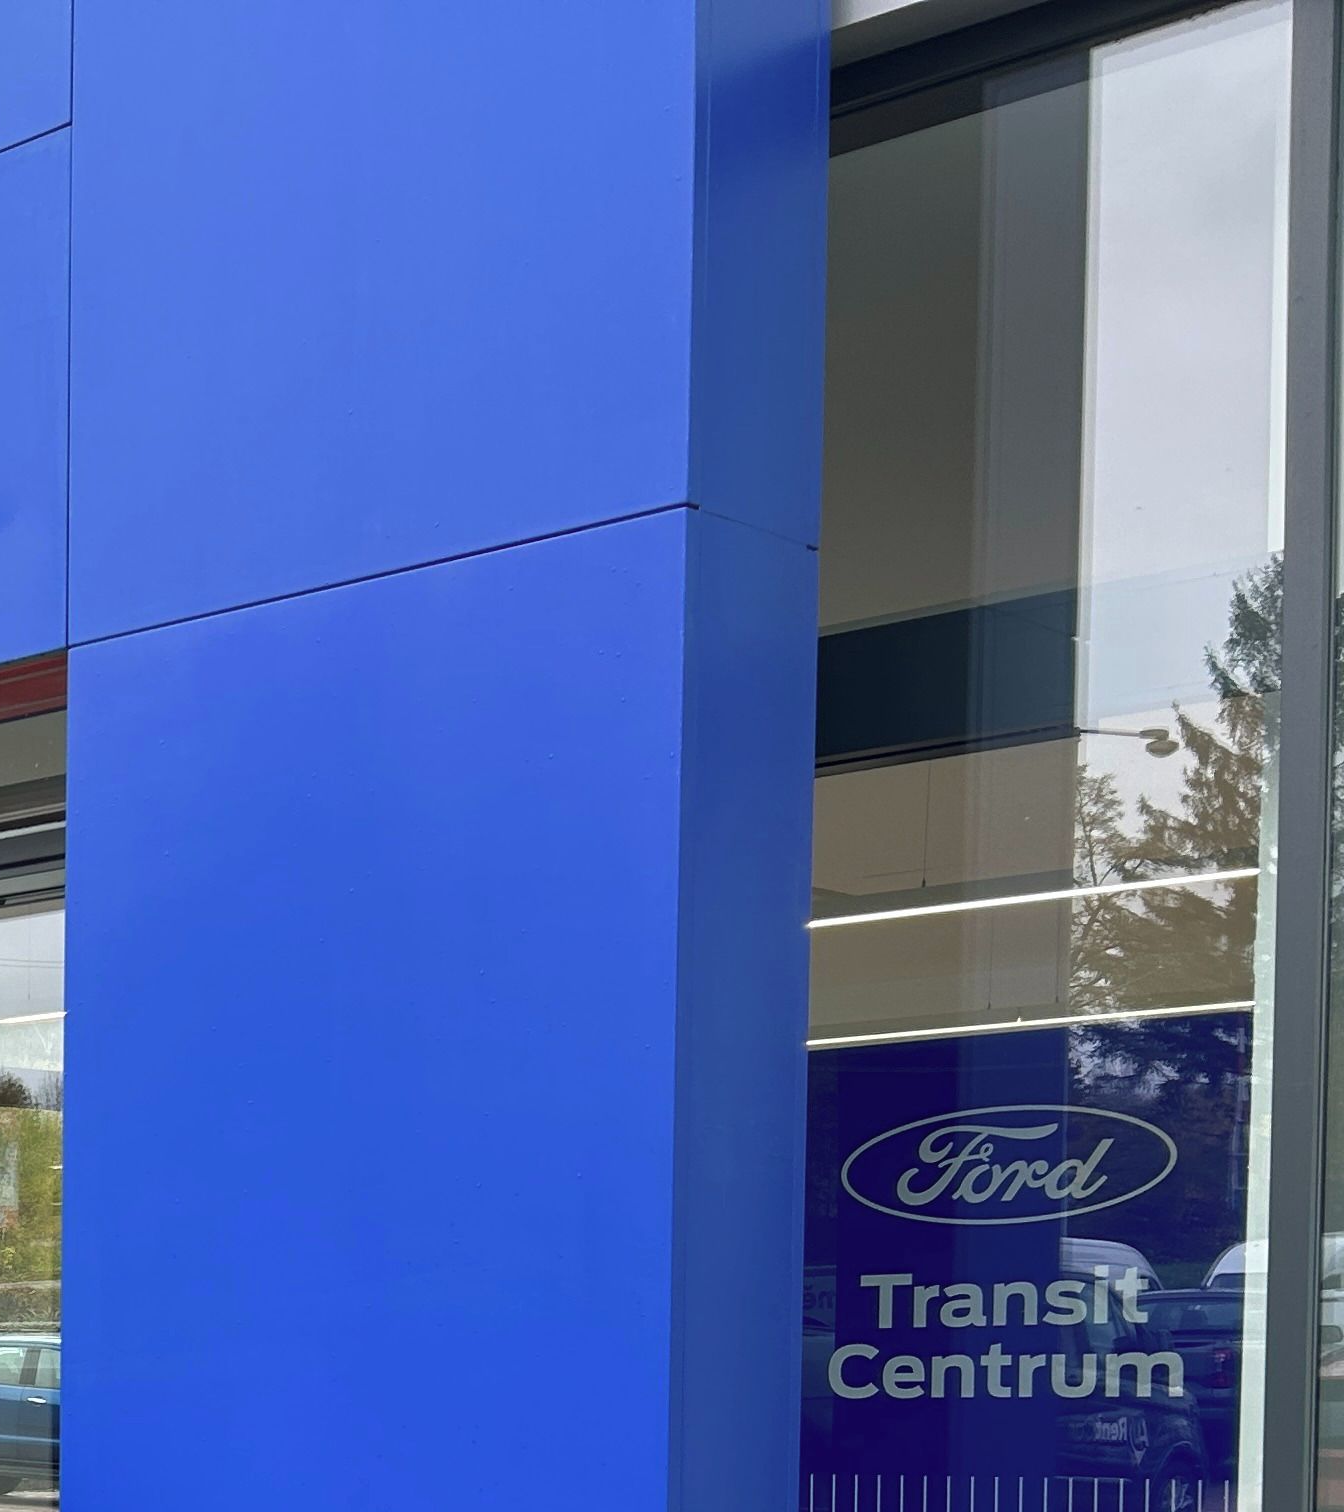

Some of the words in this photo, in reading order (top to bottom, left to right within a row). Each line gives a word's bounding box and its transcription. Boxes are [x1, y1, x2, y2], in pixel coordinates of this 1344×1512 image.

[896, 1123, 1115, 1206] Ford
[860, 1265, 1149, 1329] Transit
[827, 1343, 1185, 1399] Centrum
